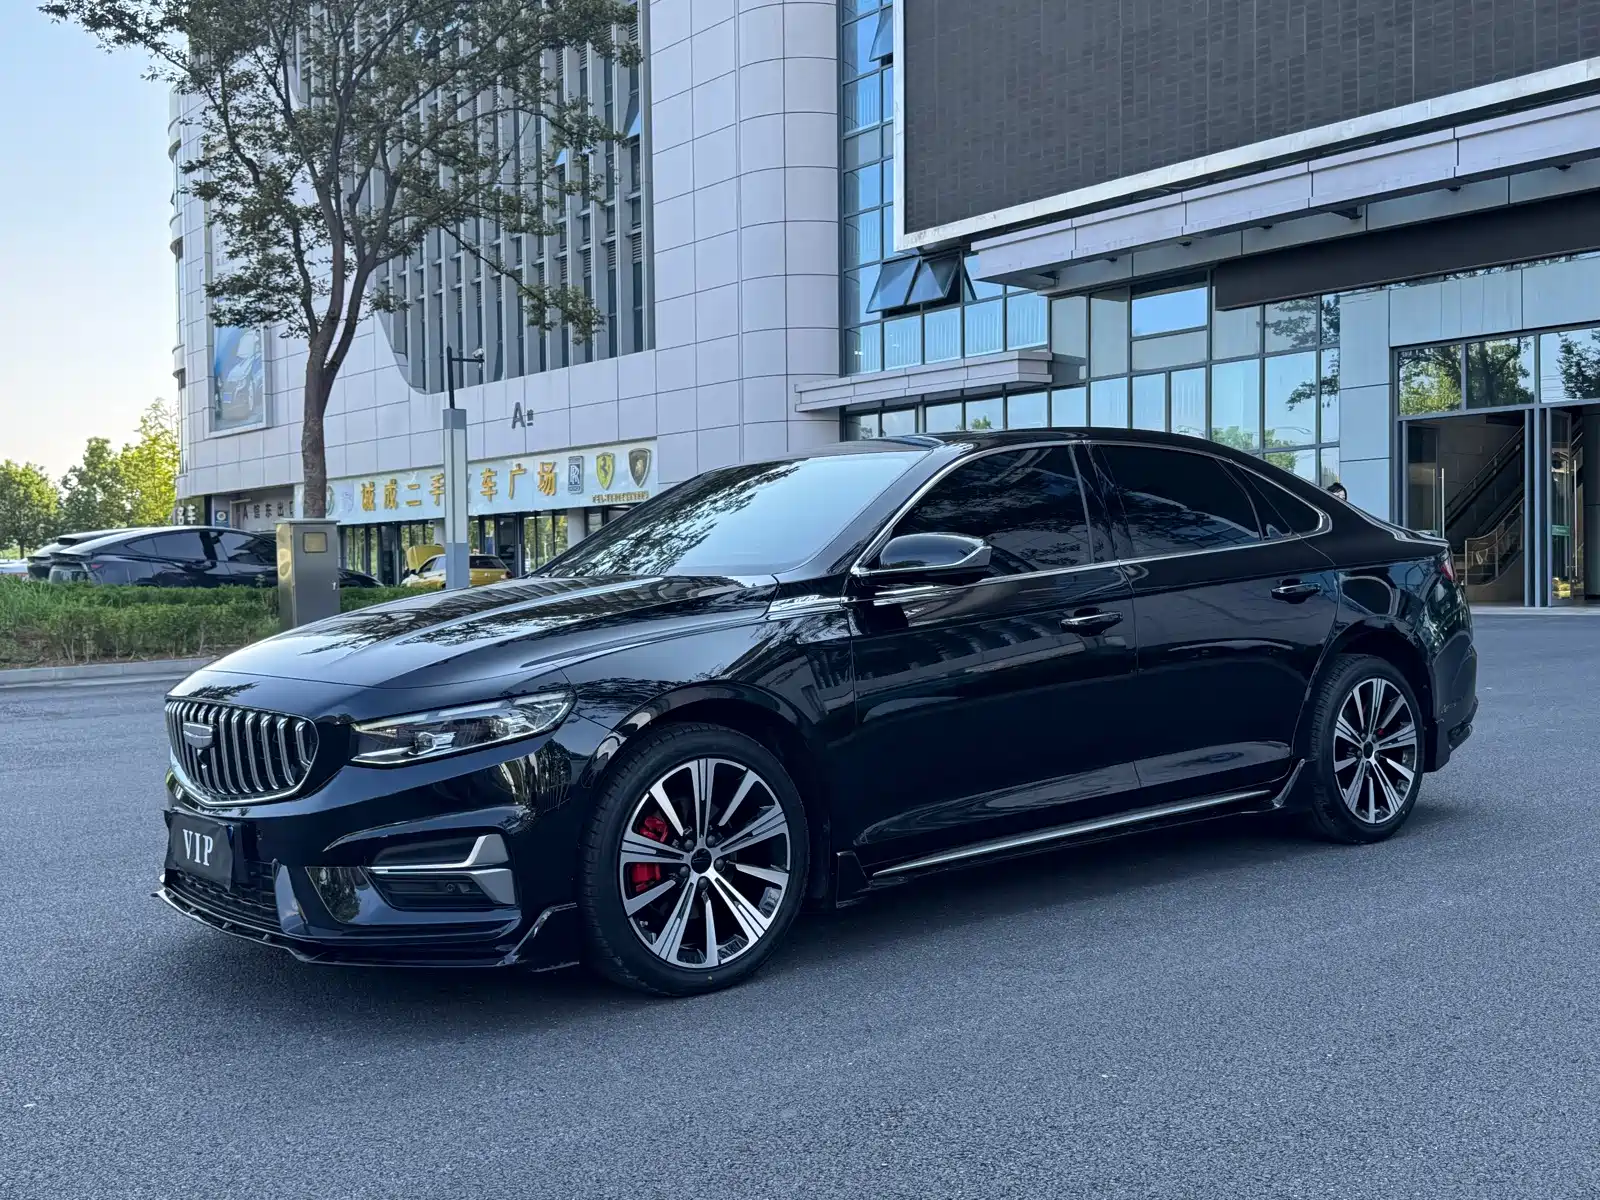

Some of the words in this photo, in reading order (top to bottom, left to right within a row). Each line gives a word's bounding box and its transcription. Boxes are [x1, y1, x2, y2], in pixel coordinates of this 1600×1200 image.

[361, 461, 557, 511] 诚成二手车广场
[182, 828, 214, 867] VIP
